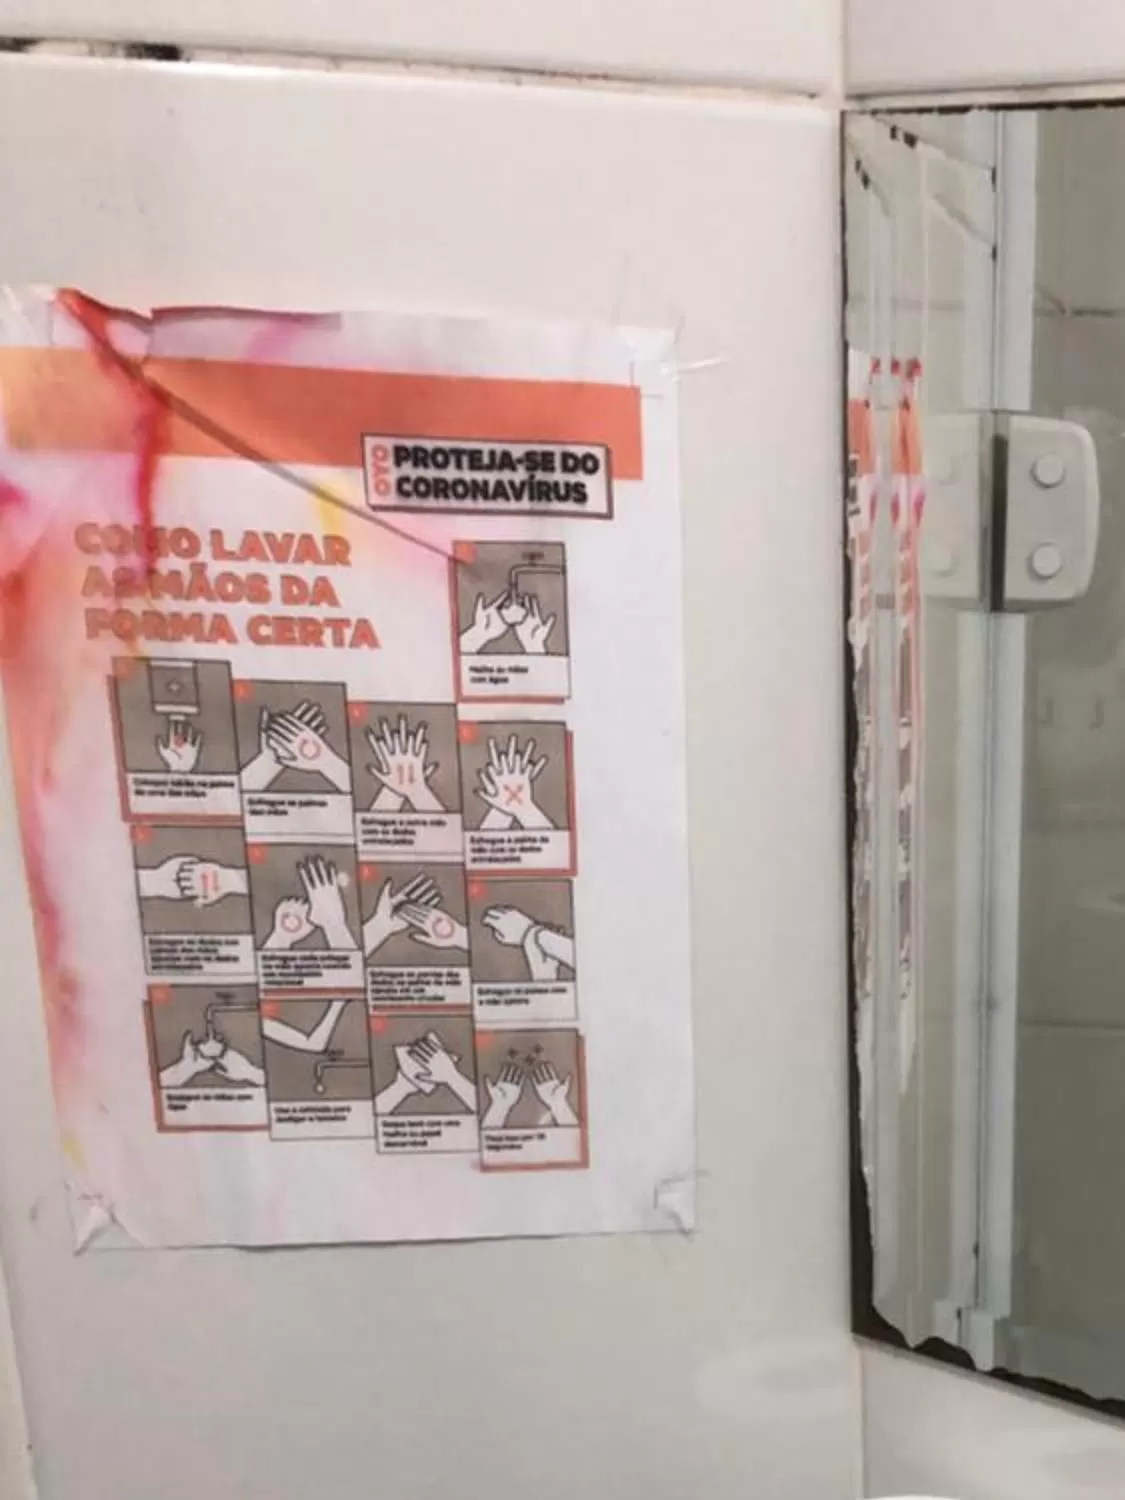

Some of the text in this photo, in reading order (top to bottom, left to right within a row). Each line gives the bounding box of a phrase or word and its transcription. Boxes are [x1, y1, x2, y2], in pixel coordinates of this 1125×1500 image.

[372, 444, 391, 496] OYO
[393, 445, 599, 475] PROTEJA-SE DO
[396, 474, 588, 504] CORONAVÍRUS
[74, 522, 352, 566] COMO LAVAR
[82, 562, 341, 607] AS MÃOS DA
[84, 608, 381, 649] FORMA CERTA
